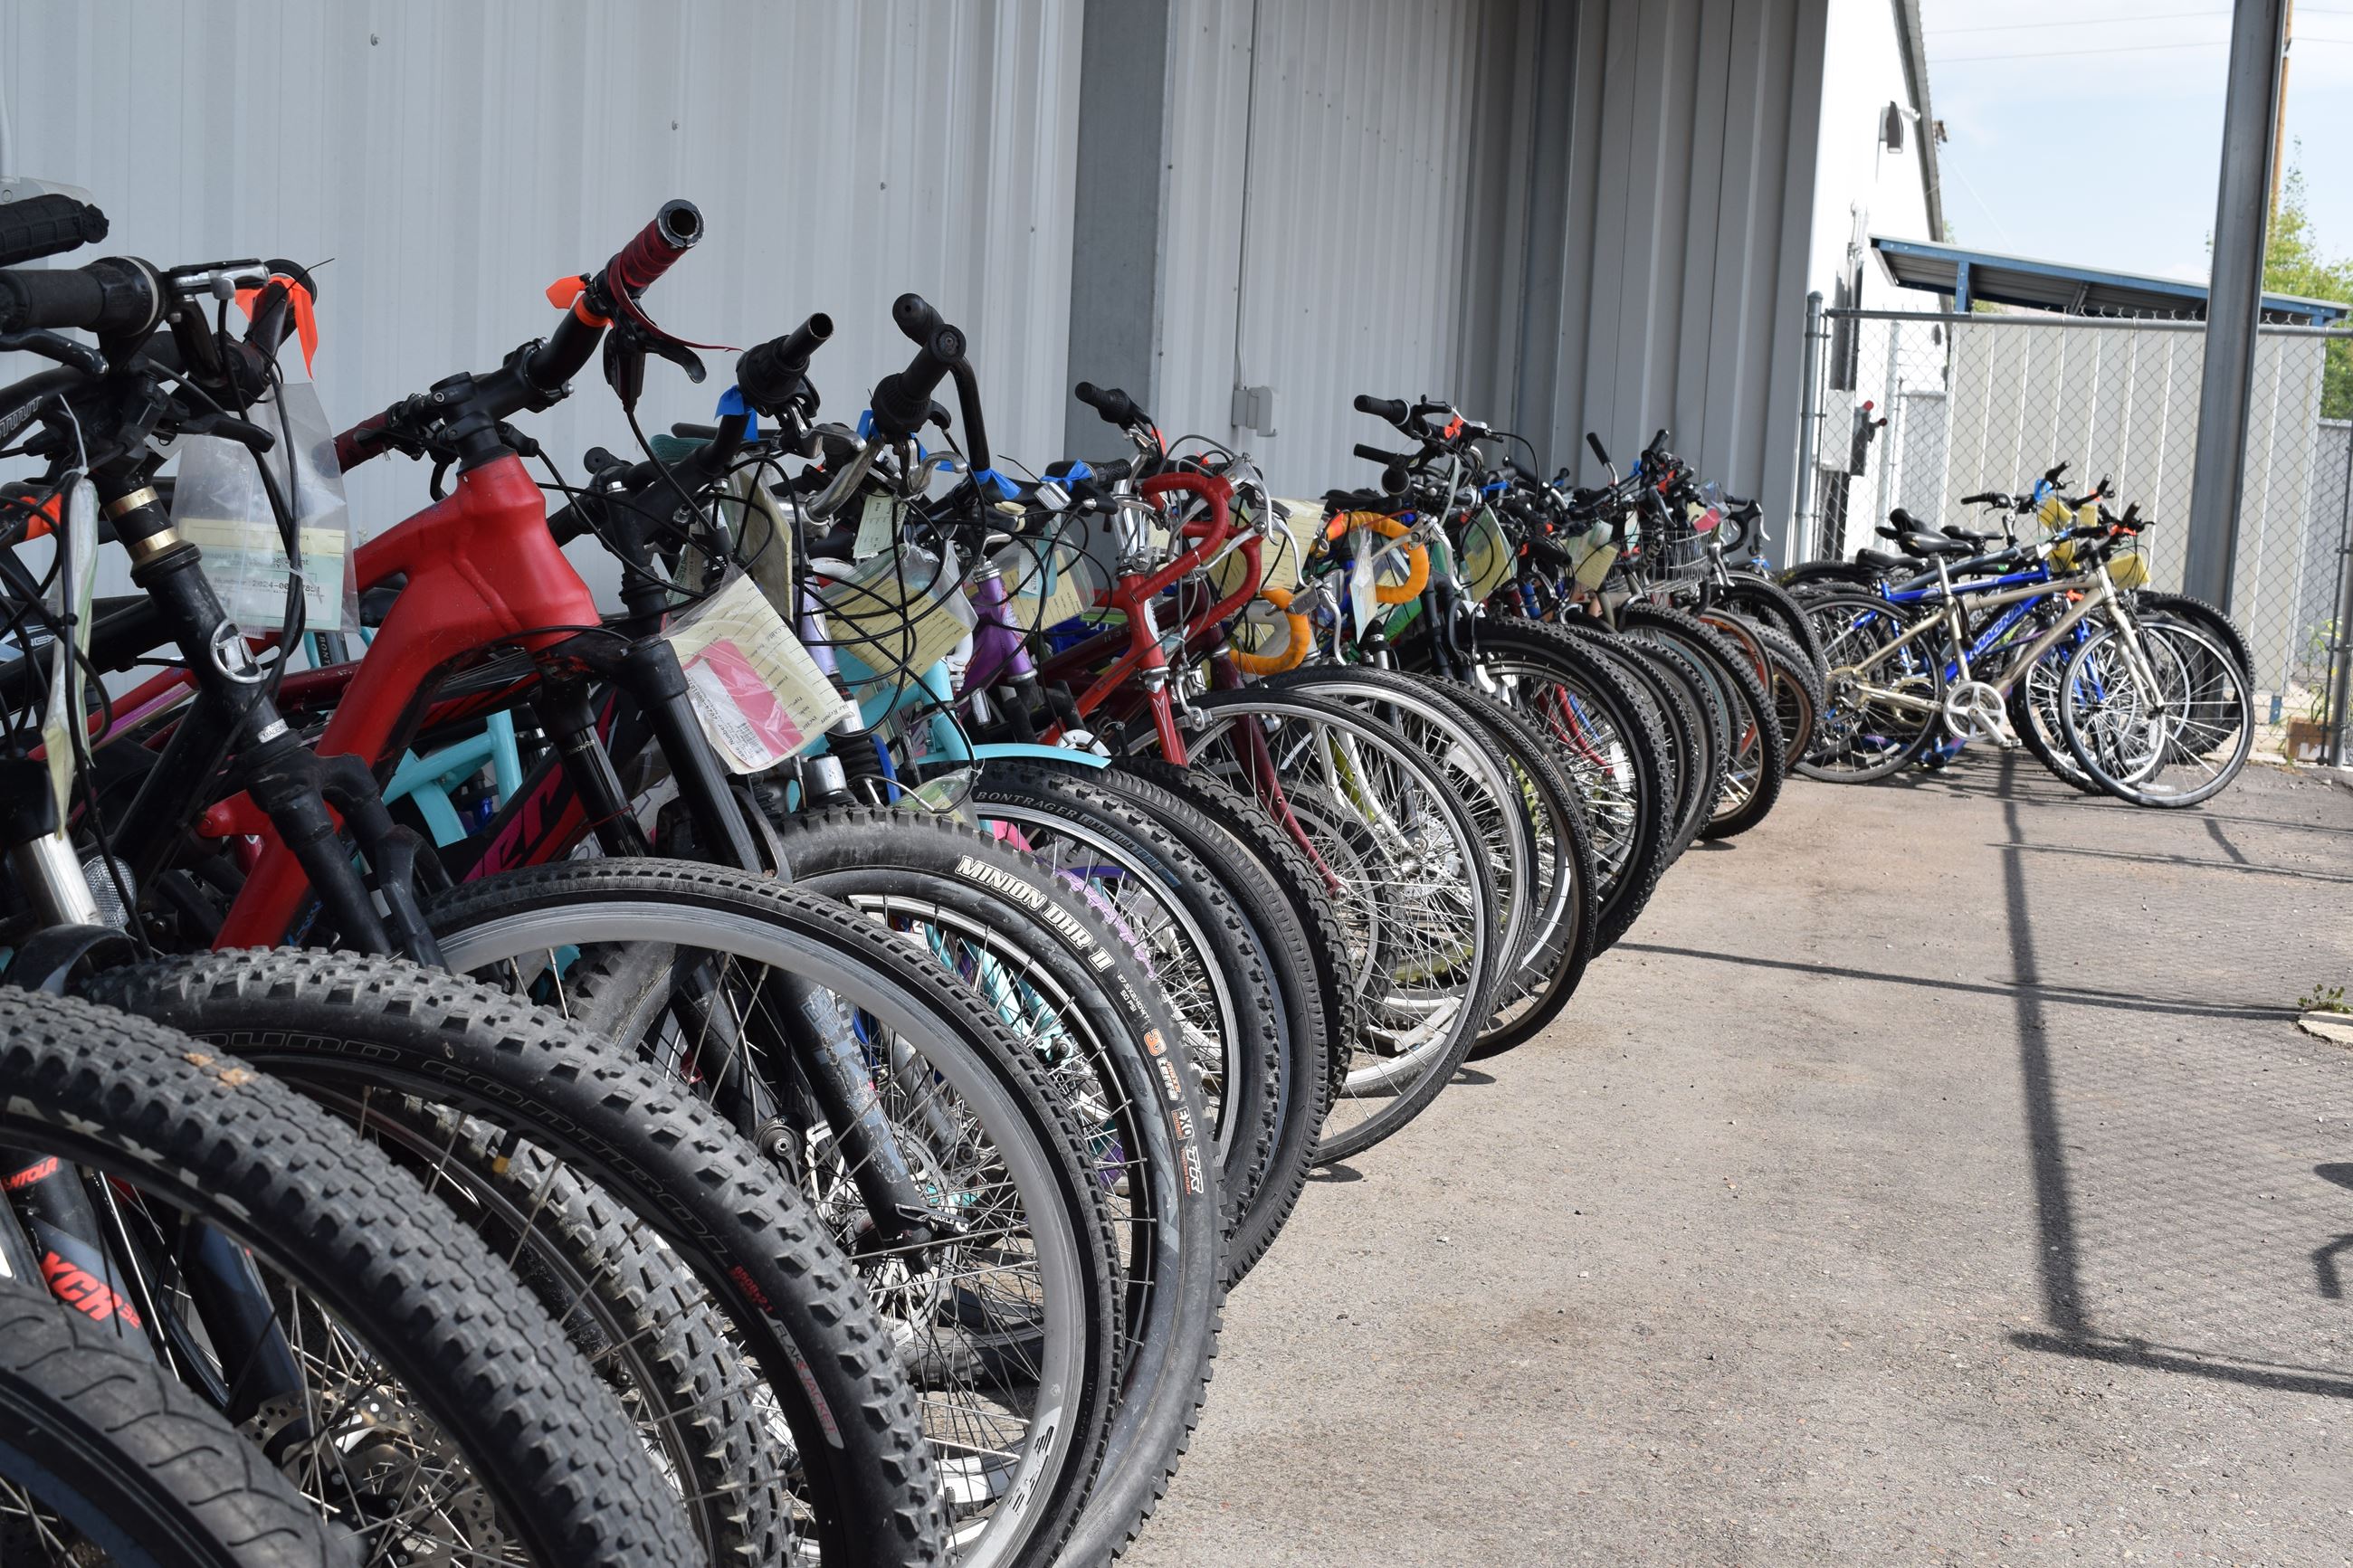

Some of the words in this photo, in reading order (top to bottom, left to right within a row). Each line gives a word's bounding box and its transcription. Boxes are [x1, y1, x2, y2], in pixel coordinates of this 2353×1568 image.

[818, 707, 839, 724] Report
[976, 792, 1078, 819] BONTRAGER
[955, 855, 1048, 911] MINION
[1042, 902, 1093, 950] DHR
[1127, 999, 1138, 1012] PSI
[1178, 1107, 1194, 1137] EXO
[1186, 1145, 1205, 1194] TR
[930, 1214, 955, 1225] MAXLE
[802, 1373, 839, 1436] JACKET
